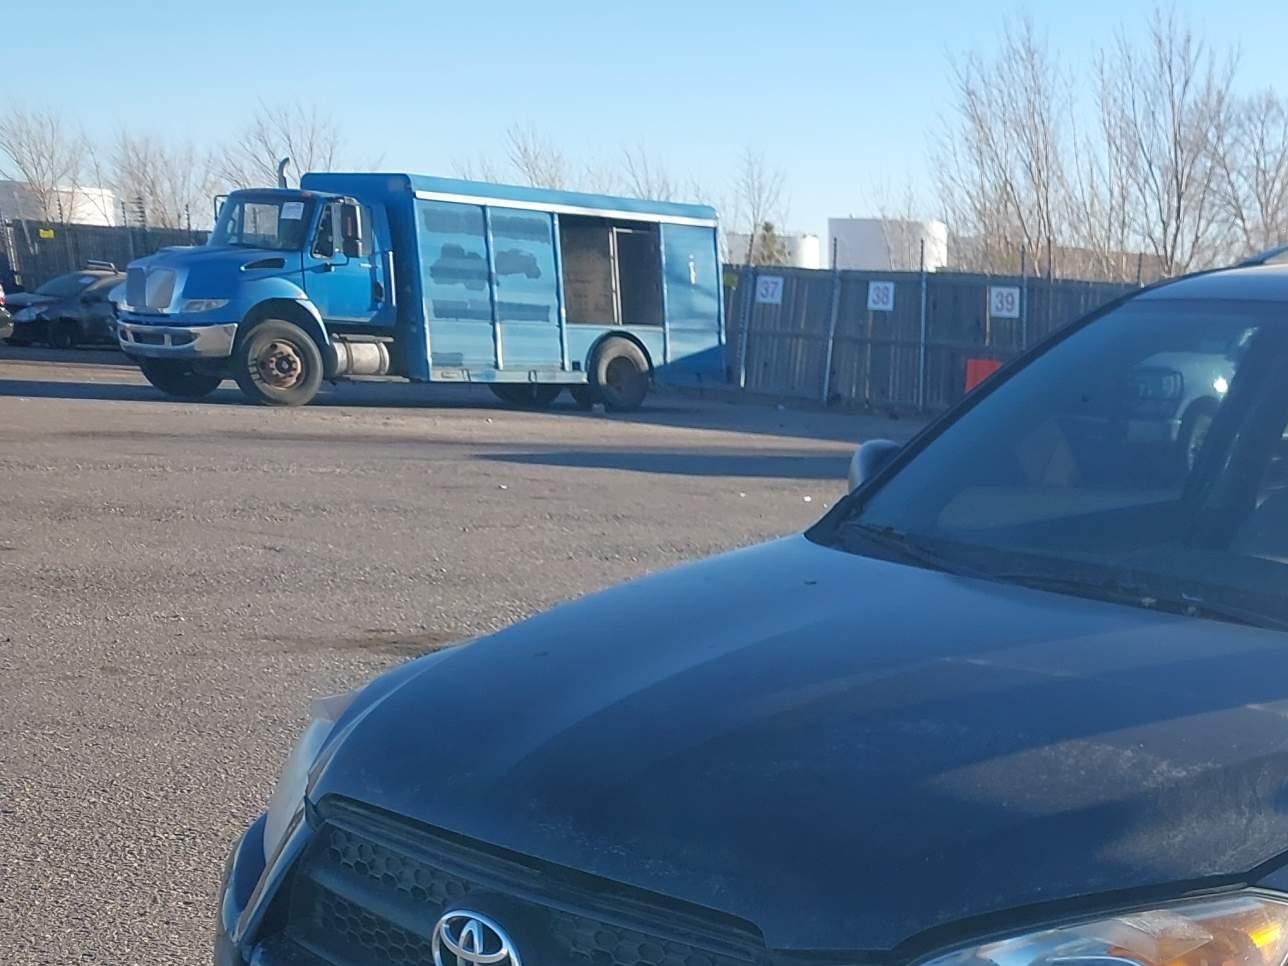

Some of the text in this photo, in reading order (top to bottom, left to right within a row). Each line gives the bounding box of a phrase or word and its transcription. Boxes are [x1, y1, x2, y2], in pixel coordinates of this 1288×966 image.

[760, 280, 779, 299] 37
[872, 286, 891, 305] 38
[995, 291, 1015, 312] 39
